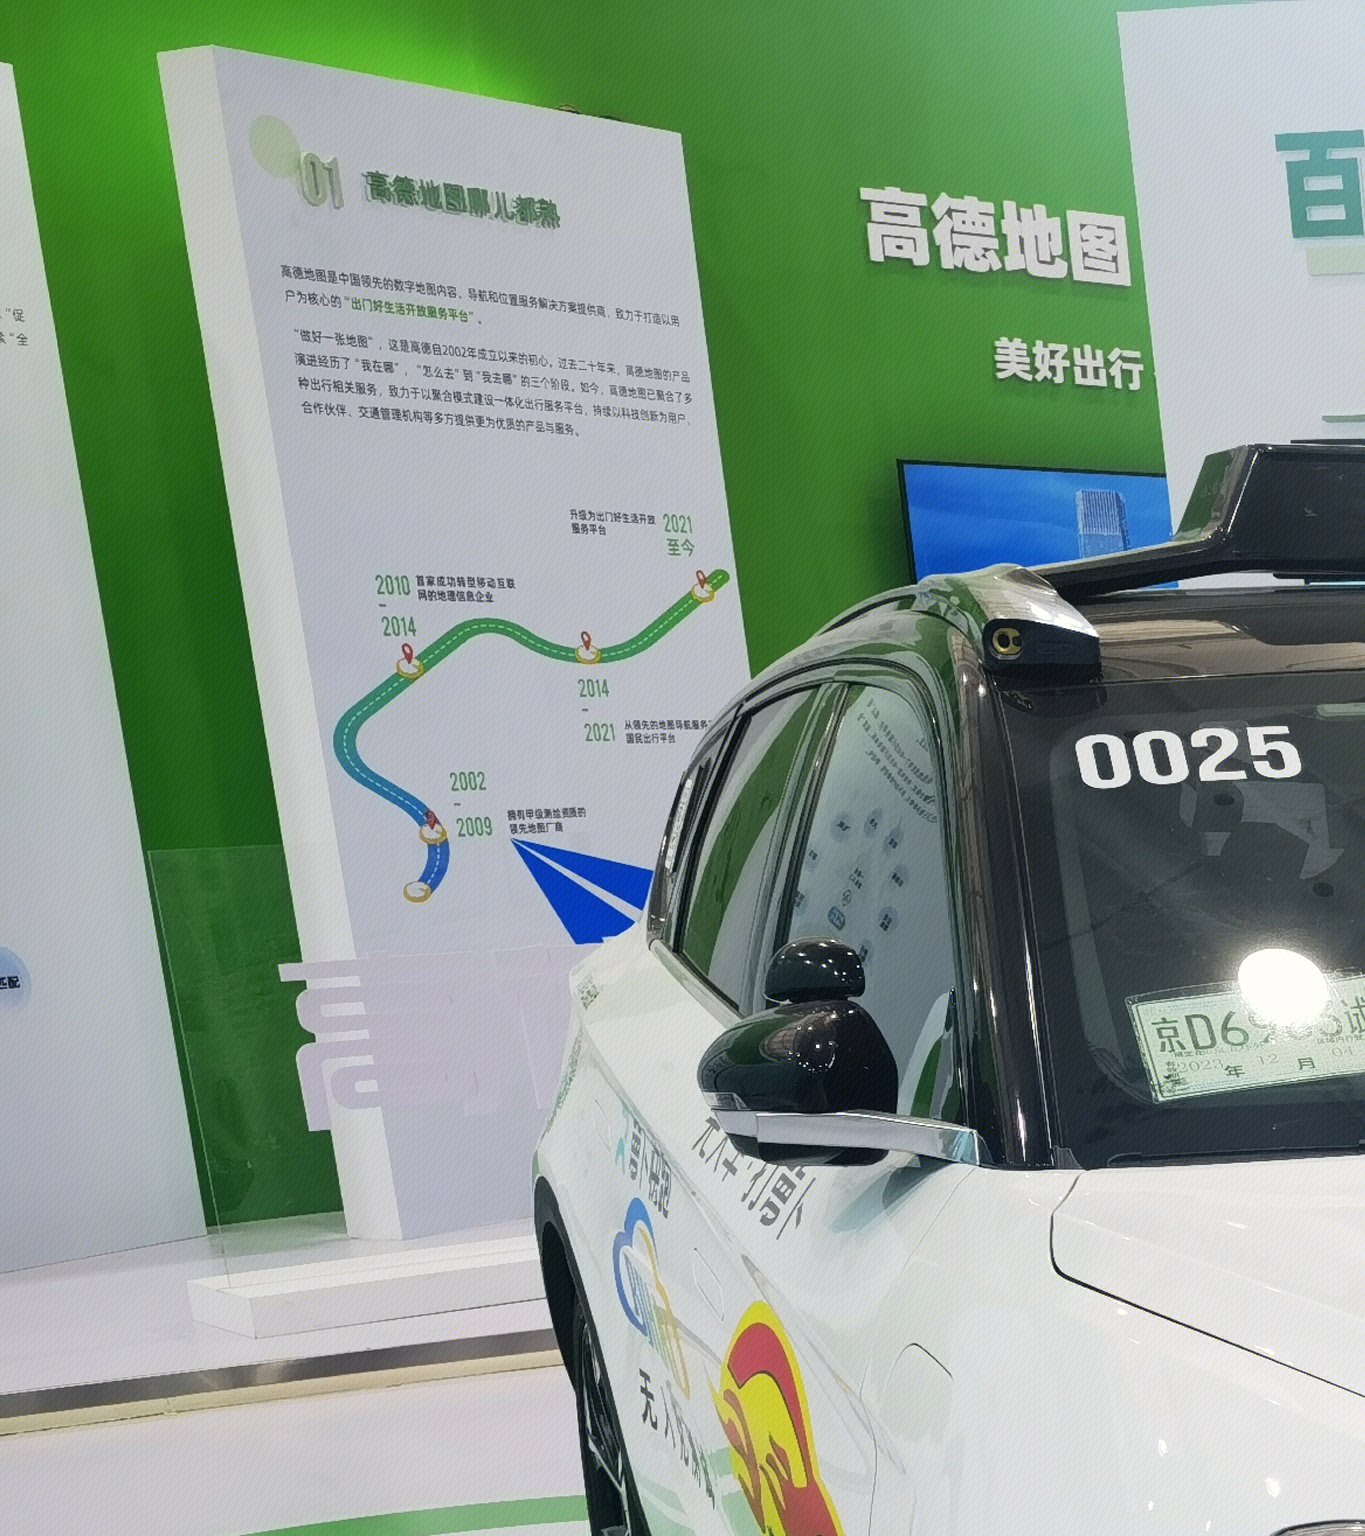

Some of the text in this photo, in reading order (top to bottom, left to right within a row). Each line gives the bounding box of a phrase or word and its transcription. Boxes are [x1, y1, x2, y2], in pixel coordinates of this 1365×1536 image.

[300, 152, 561, 231] 01 高德地图哪儿都熟
[859, 186, 1132, 287] 高德地图
[994, 336, 1144, 391] 美好出行
[663, 514, 693, 534] 2021
[666, 538, 695, 557] 至今
[375, 575, 411, 596] 2010
[382, 616, 417, 637] 2014
[578, 679, 609, 698] 2014
[584, 723, 616, 742] 2021
[1074, 725, 1302, 789] 0025
[449, 772, 487, 792] 2002
[456, 816, 493, 837] 2009
[1224, 1064, 1246, 1078] 年
[1297, 1057, 1316, 1070] 月
